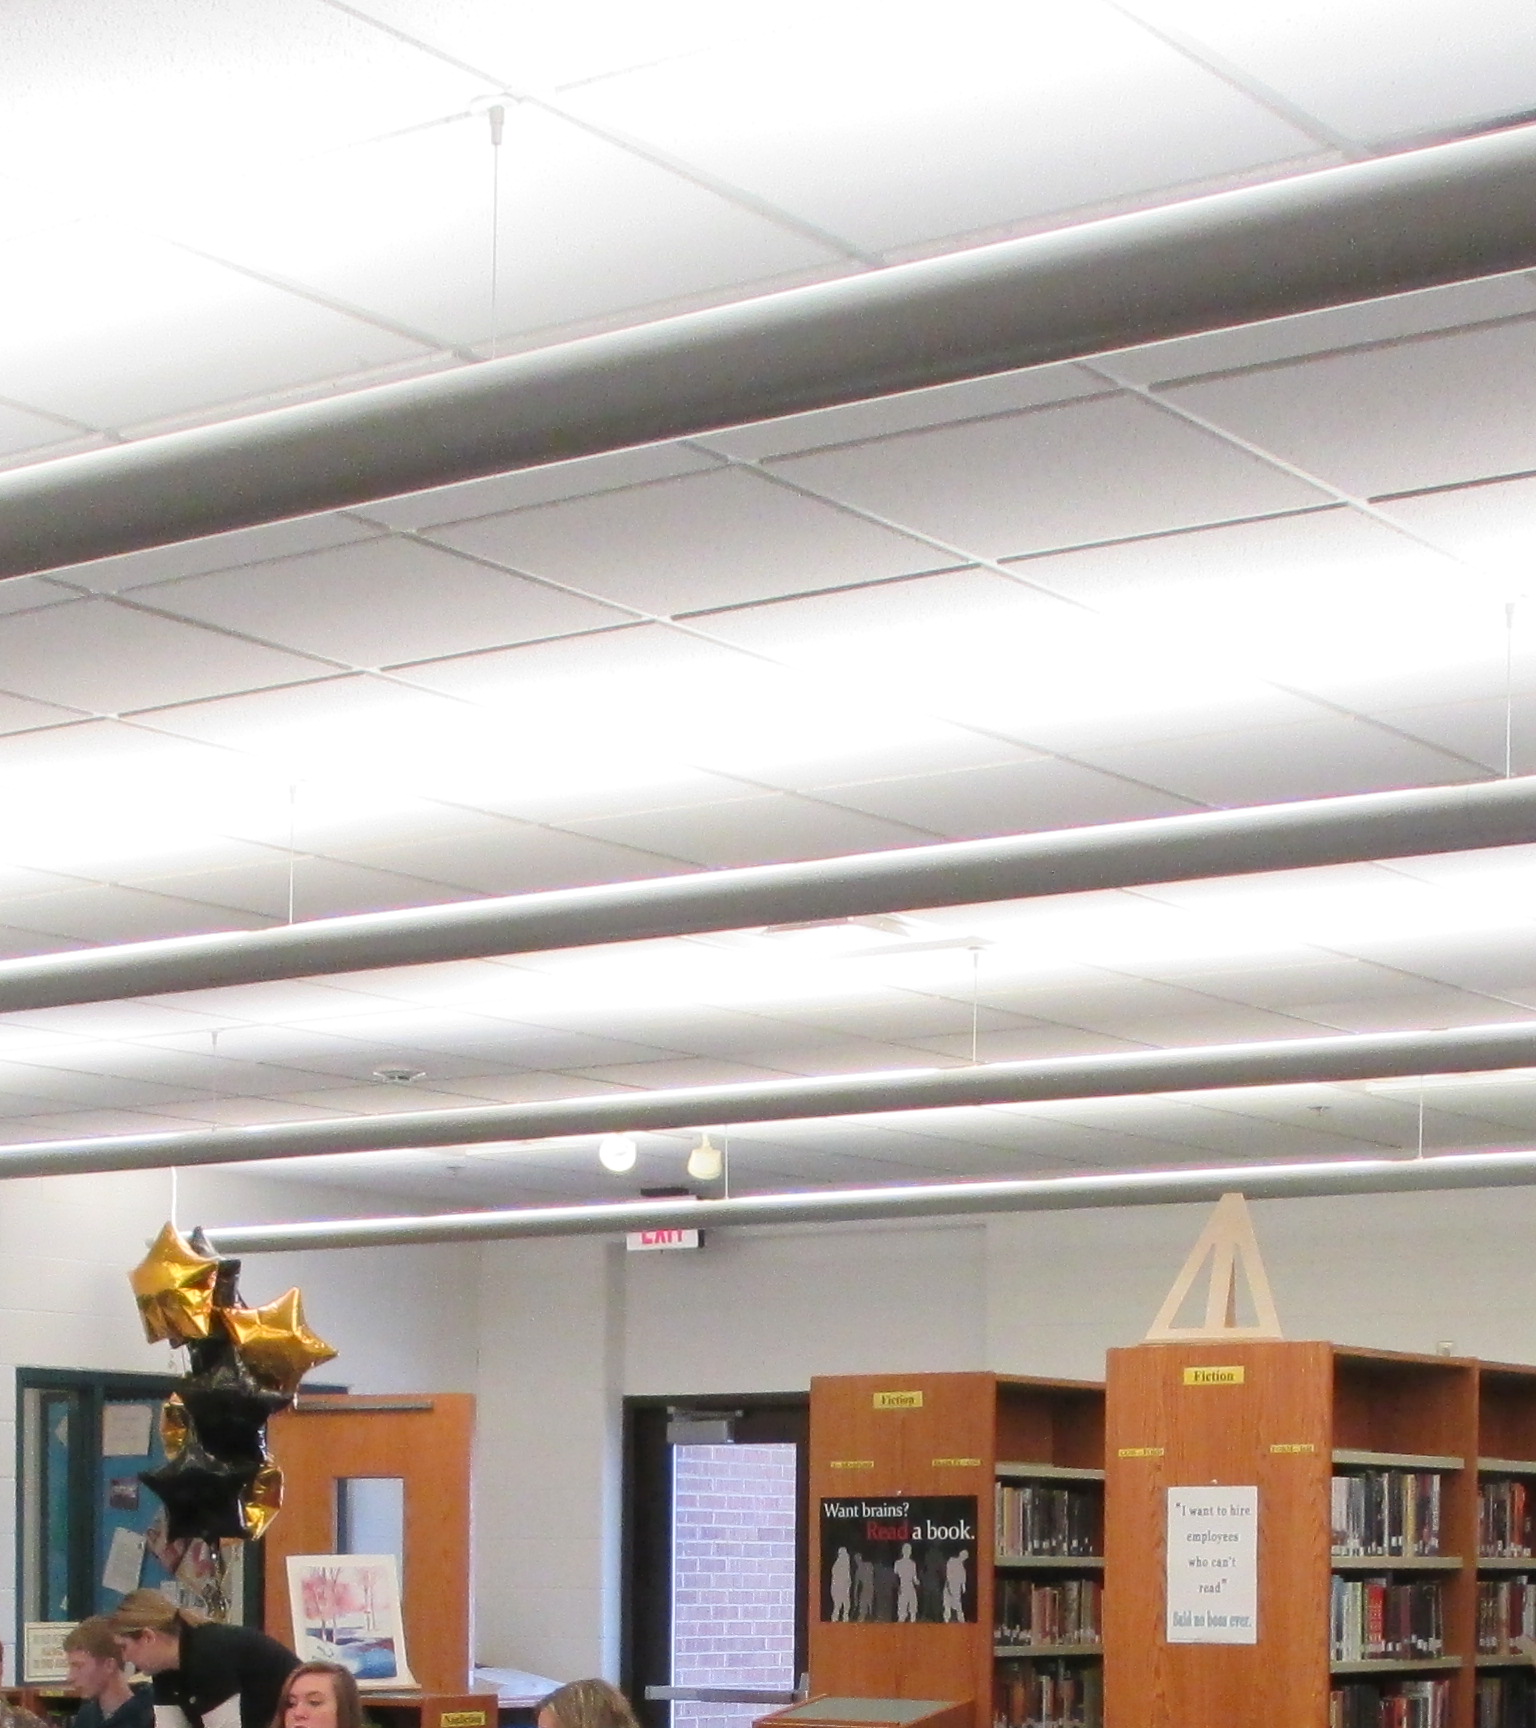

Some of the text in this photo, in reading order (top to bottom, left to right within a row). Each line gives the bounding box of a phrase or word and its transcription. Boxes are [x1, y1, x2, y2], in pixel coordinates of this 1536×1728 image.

[1193, 1369, 1234, 1382] Fiction
[881, 1394, 915, 1406] Fiction
[824, 1502, 910, 1518] Want brains?
[1189, 1505, 1213, 1516] want
[1217, 1505, 1227, 1516] to
[1230, 1505, 1251, 1516] hire
[867, 1519, 975, 1541] Read a book.
[1186, 1530, 1239, 1545] employees
[1188, 1556, 1236, 1567] who can't
